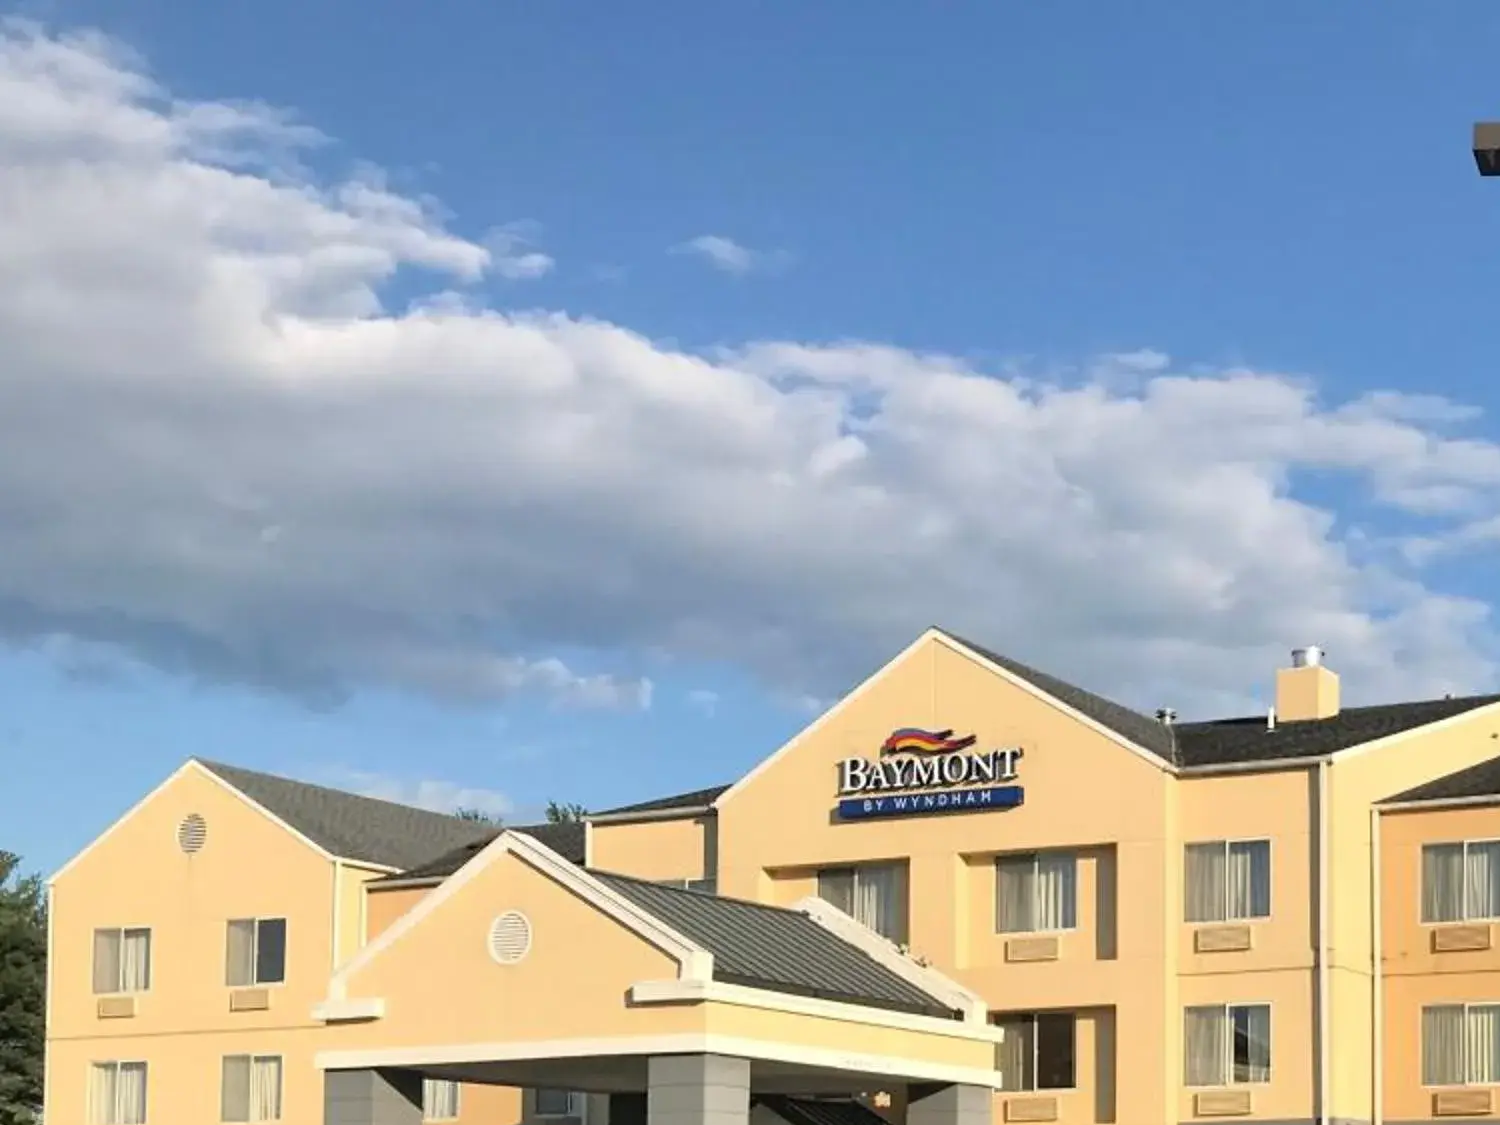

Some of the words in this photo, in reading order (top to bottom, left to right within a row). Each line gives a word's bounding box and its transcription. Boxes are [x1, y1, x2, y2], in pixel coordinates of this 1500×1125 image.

[839, 748, 1023, 793] BAYMONT
[862, 800, 884, 812] BY
[894, 791, 993, 810] WYNDHAM
